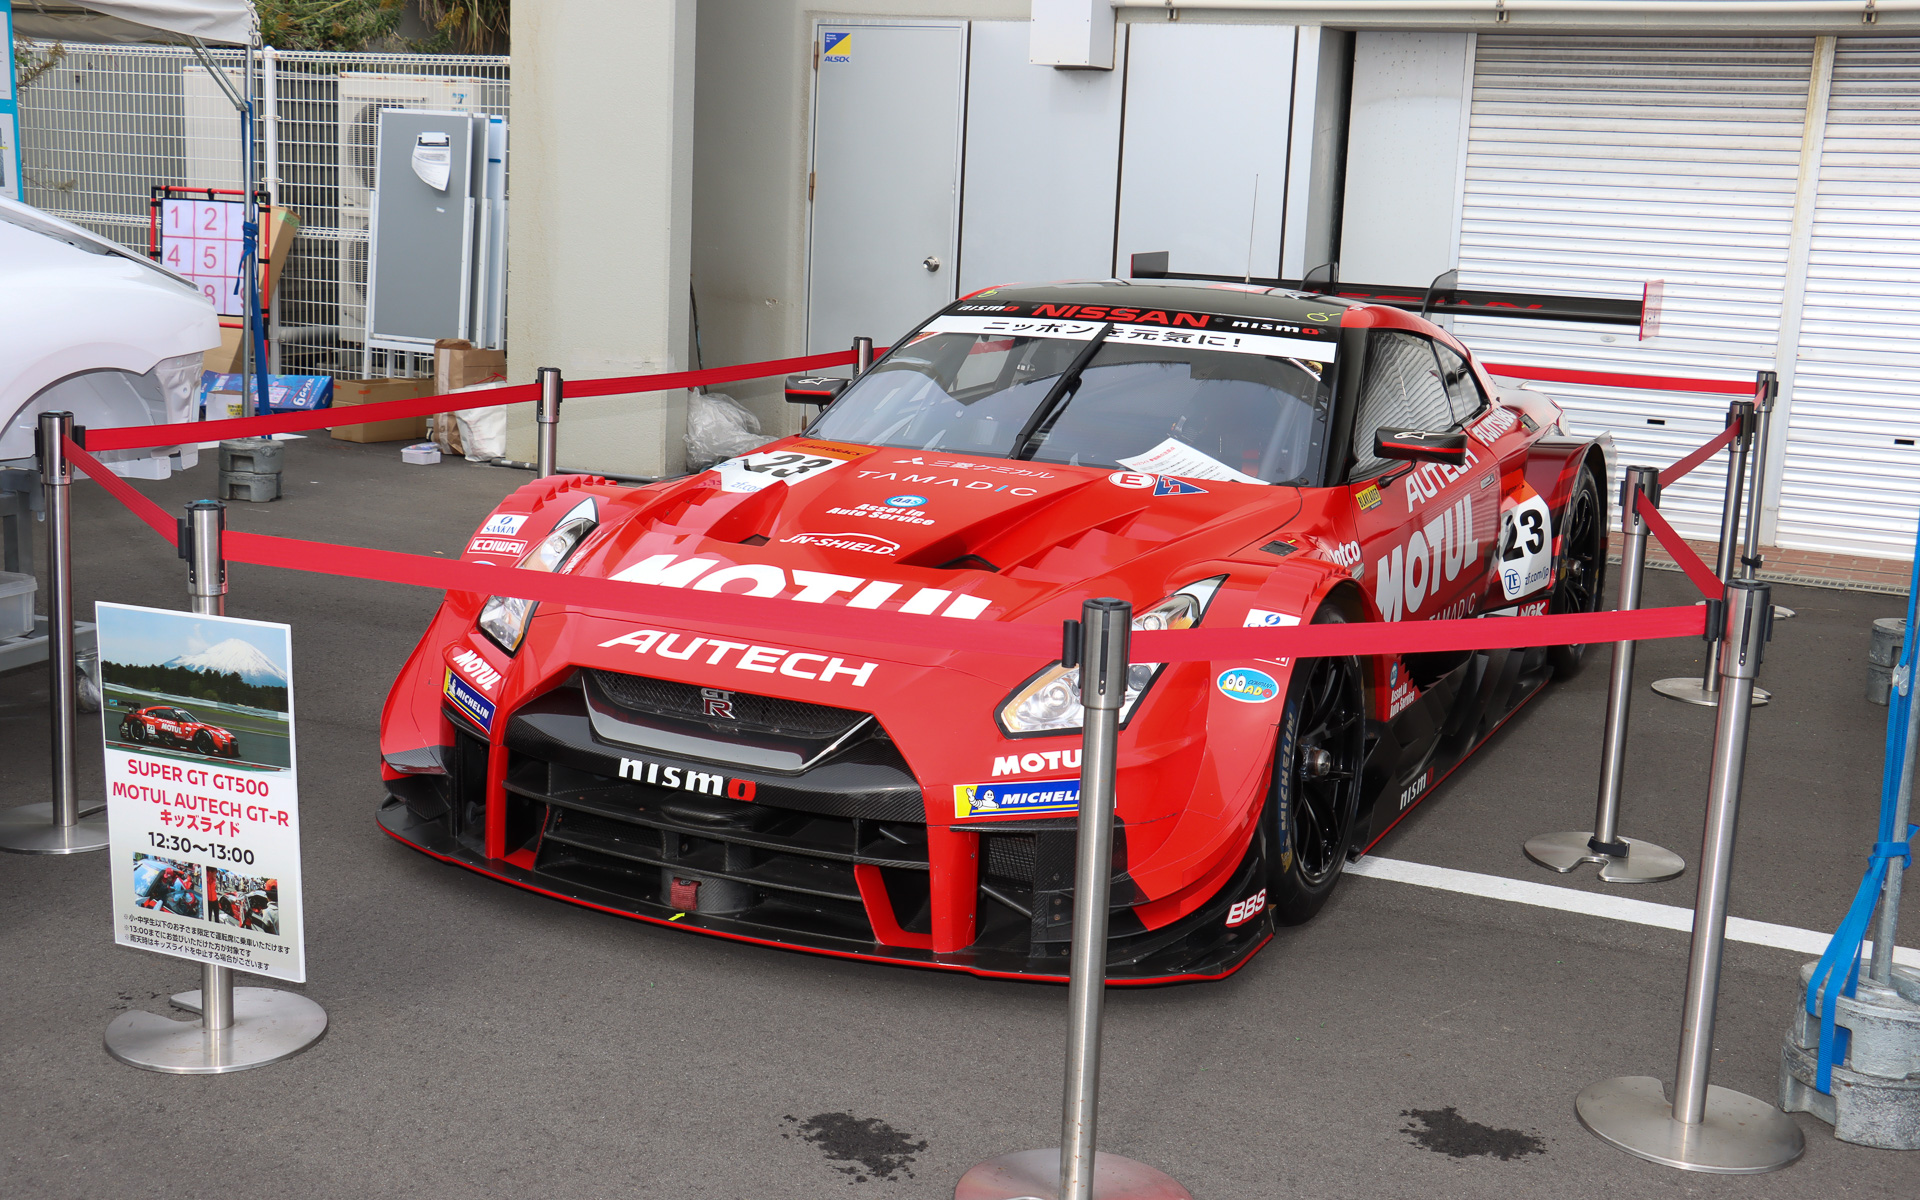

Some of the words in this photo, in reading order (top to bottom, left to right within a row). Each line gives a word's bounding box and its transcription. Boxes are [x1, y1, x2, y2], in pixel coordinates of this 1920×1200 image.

[824, 55, 850, 63] ALSOK
[170, 205, 179, 229] 1
[203, 207, 218, 231] 2
[167, 244, 181, 267] 4
[203, 246, 217, 269] 5
[204, 284, 216, 305] 8
[1032, 304, 1210, 328] NISSAN
[1231, 320, 1319, 335] nismo
[1471, 405, 1518, 447] FUJITSUBO
[742, 454, 833, 478] 23
[929, 460, 1055, 479] 三菱ケミカル
[857, 470, 1037, 496] TAMADIC
[1120, 474, 1143, 486] E
[826, 507, 868, 516] Auto
[868, 511, 936, 525] Service
[855, 503, 906, 515] Asset
[485, 525, 517, 534] SANKIN
[1503, 509, 1544, 562] 23
[1375, 494, 1479, 622] MOTUL
[1504, 573, 1521, 592] ZF
[1525, 567, 1549, 586] zf.com/jp
[1520, 602, 1546, 616] NGK
[452, 649, 502, 691] MOTUL
[598, 629, 879, 687] AUTECH
[456, 687, 489, 720] MICHELIN
[701, 687, 736, 699] GT
[1391, 685, 1403, 704] Asset
[1399, 690, 1415, 713] Service
[702, 698, 736, 719] R
[161, 723, 182, 734] MOTUL
[991, 749, 1082, 776] MOTU
[1280, 712, 1295, 832] MICHELIN
[128, 759, 183, 782] SUPER
[187, 769, 208, 787] GT
[213, 773, 269, 797] GT500
[618, 757, 757, 801] nismo
[1399, 766, 1434, 810] nismo
[112, 781, 171, 806] MOTUL
[174, 793, 242, 819] AUTECH
[246, 805, 289, 827] GT-R
[1001, 790, 1080, 805] MICHELI
[160, 809, 240, 838] キッズライド
[1227, 889, 1266, 925] BBS
